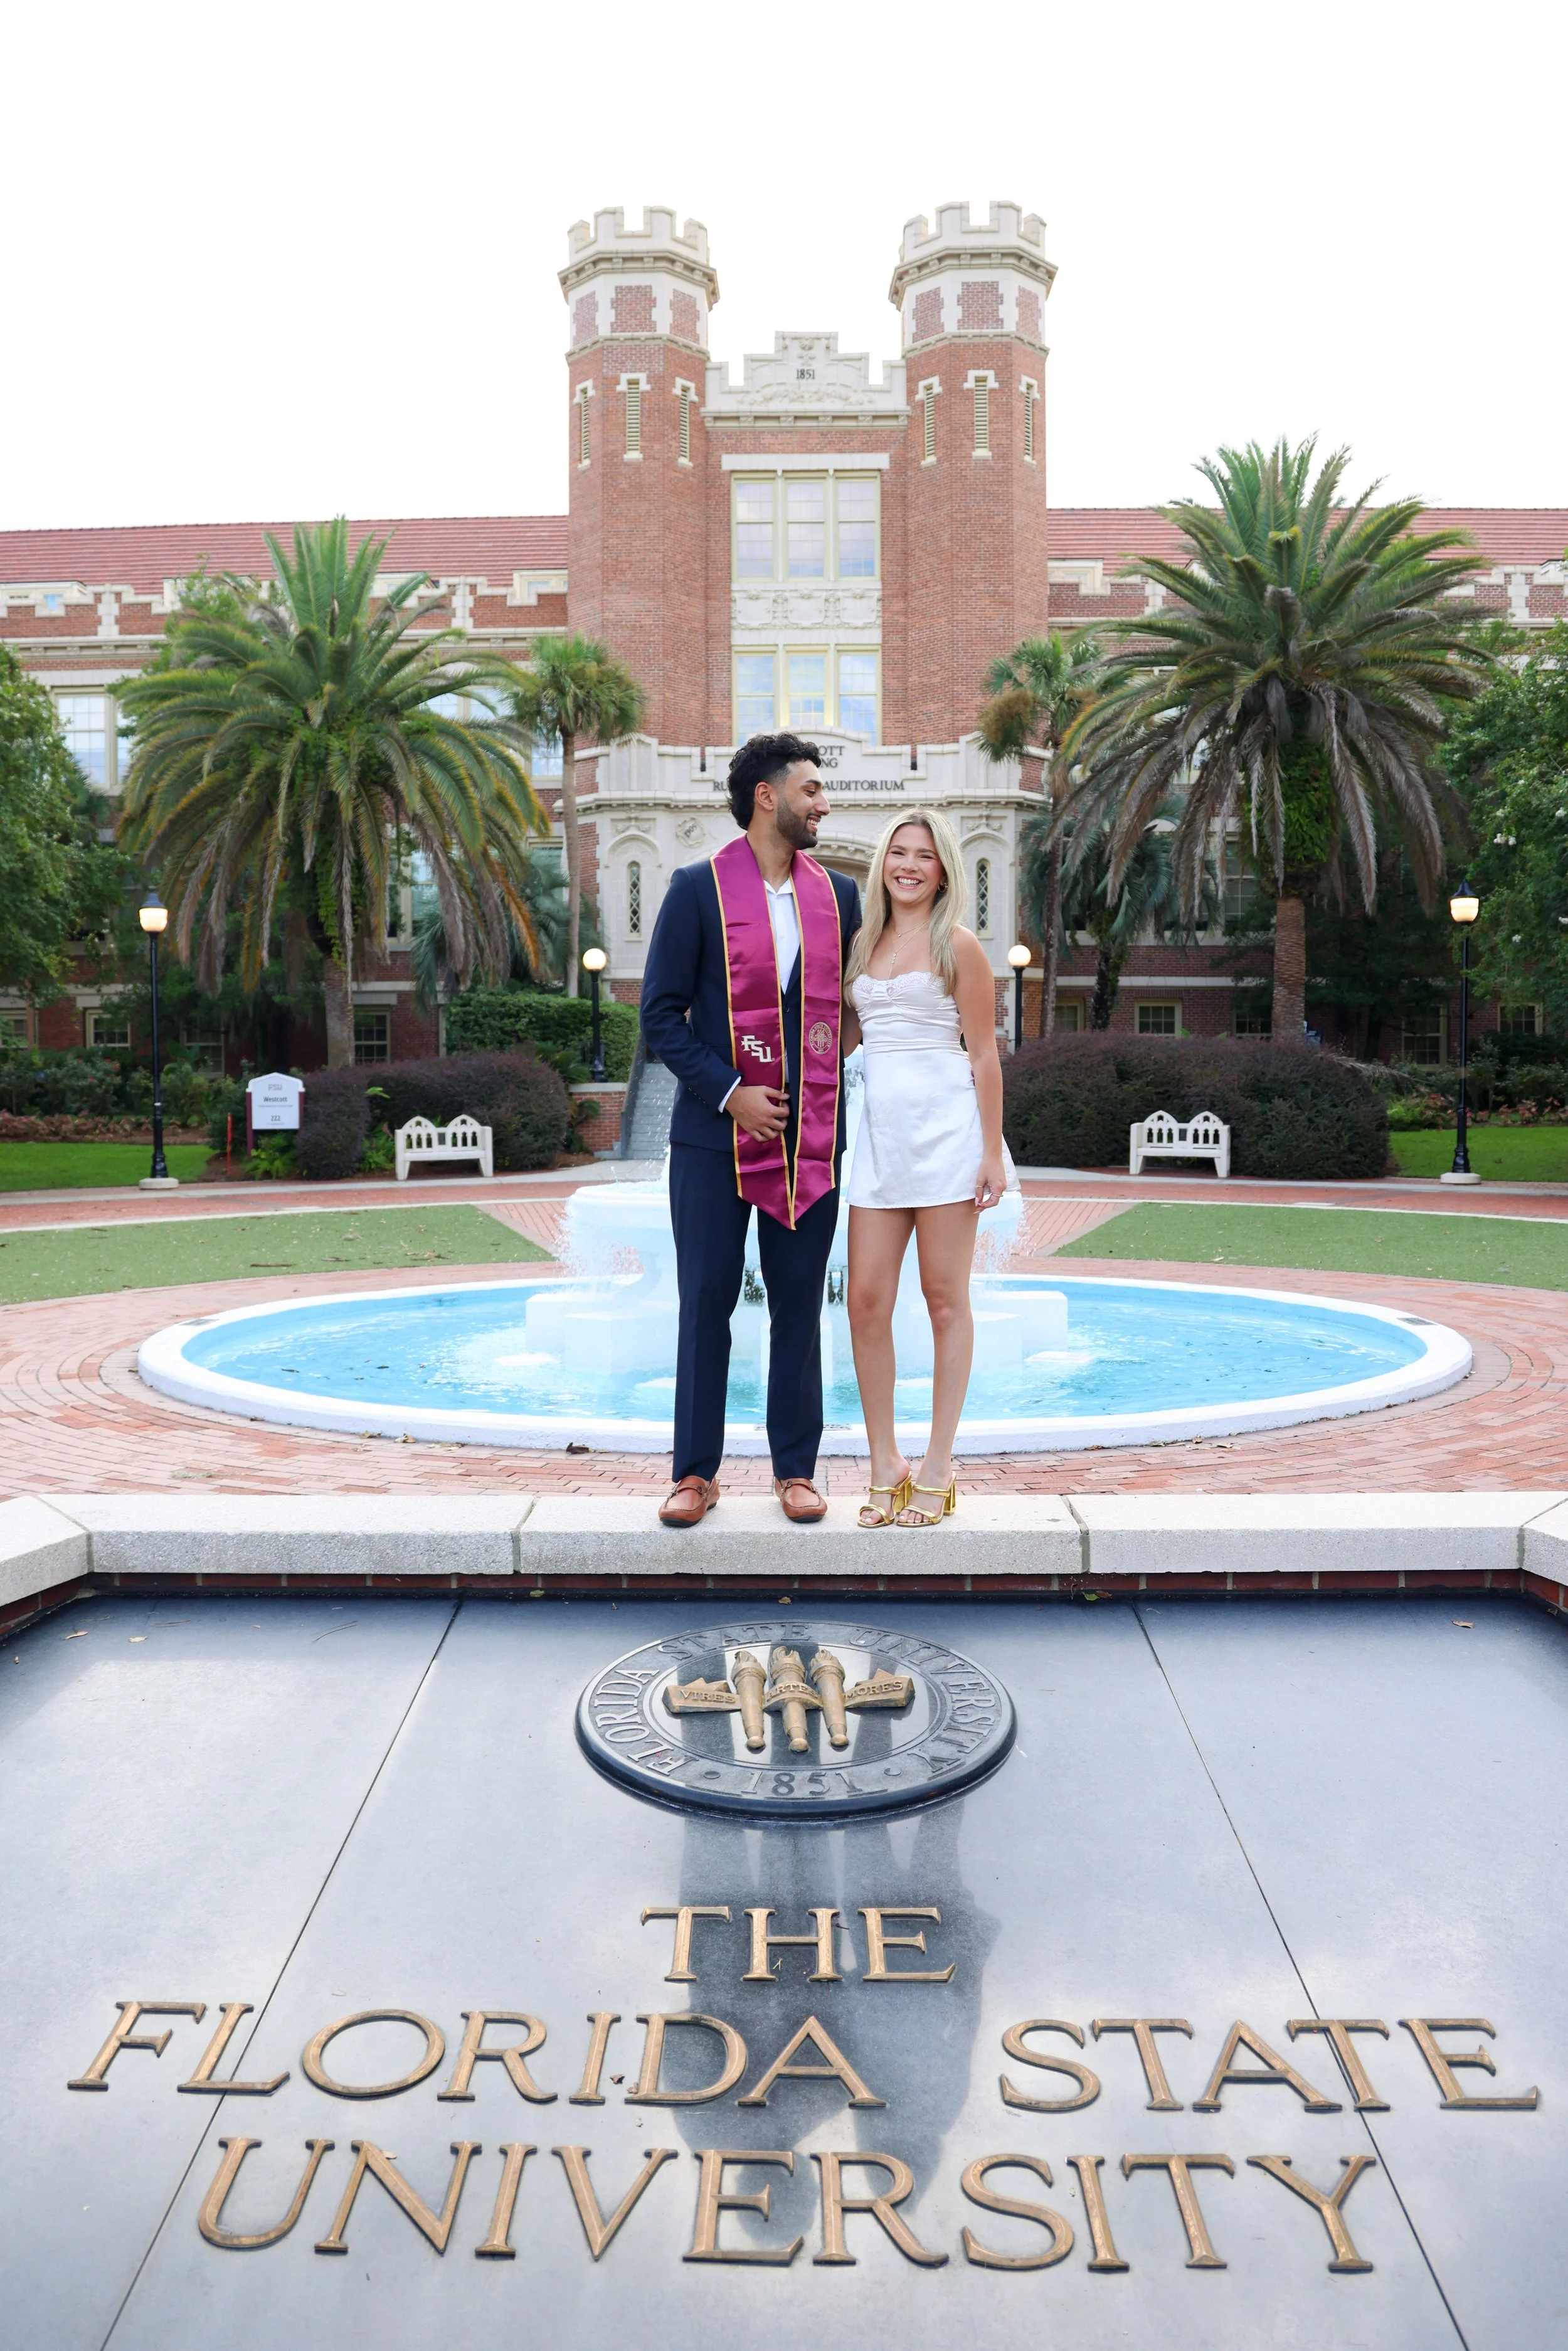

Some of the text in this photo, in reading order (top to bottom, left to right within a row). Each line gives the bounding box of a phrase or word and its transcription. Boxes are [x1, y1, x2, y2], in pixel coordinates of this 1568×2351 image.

[796, 368, 815, 379] 1851
[824, 780, 905, 790] AUDITORIUM
[741, 1035, 773, 1063] FSU
[594, 1623, 996, 1776] FLORIDA STATE UNIVERSITY
[680, 1689, 736, 1704] VIRES
[766, 1683, 820, 1701] ARTES
[844, 1681, 903, 1702] MORES
[741, 1771, 863, 1796] 1851
[641, 1906, 956, 1982] THE
[66, 2000, 1539, 2113] FLORIDA STATE
[198, 2136, 1377, 2273] UNIVERSITY
